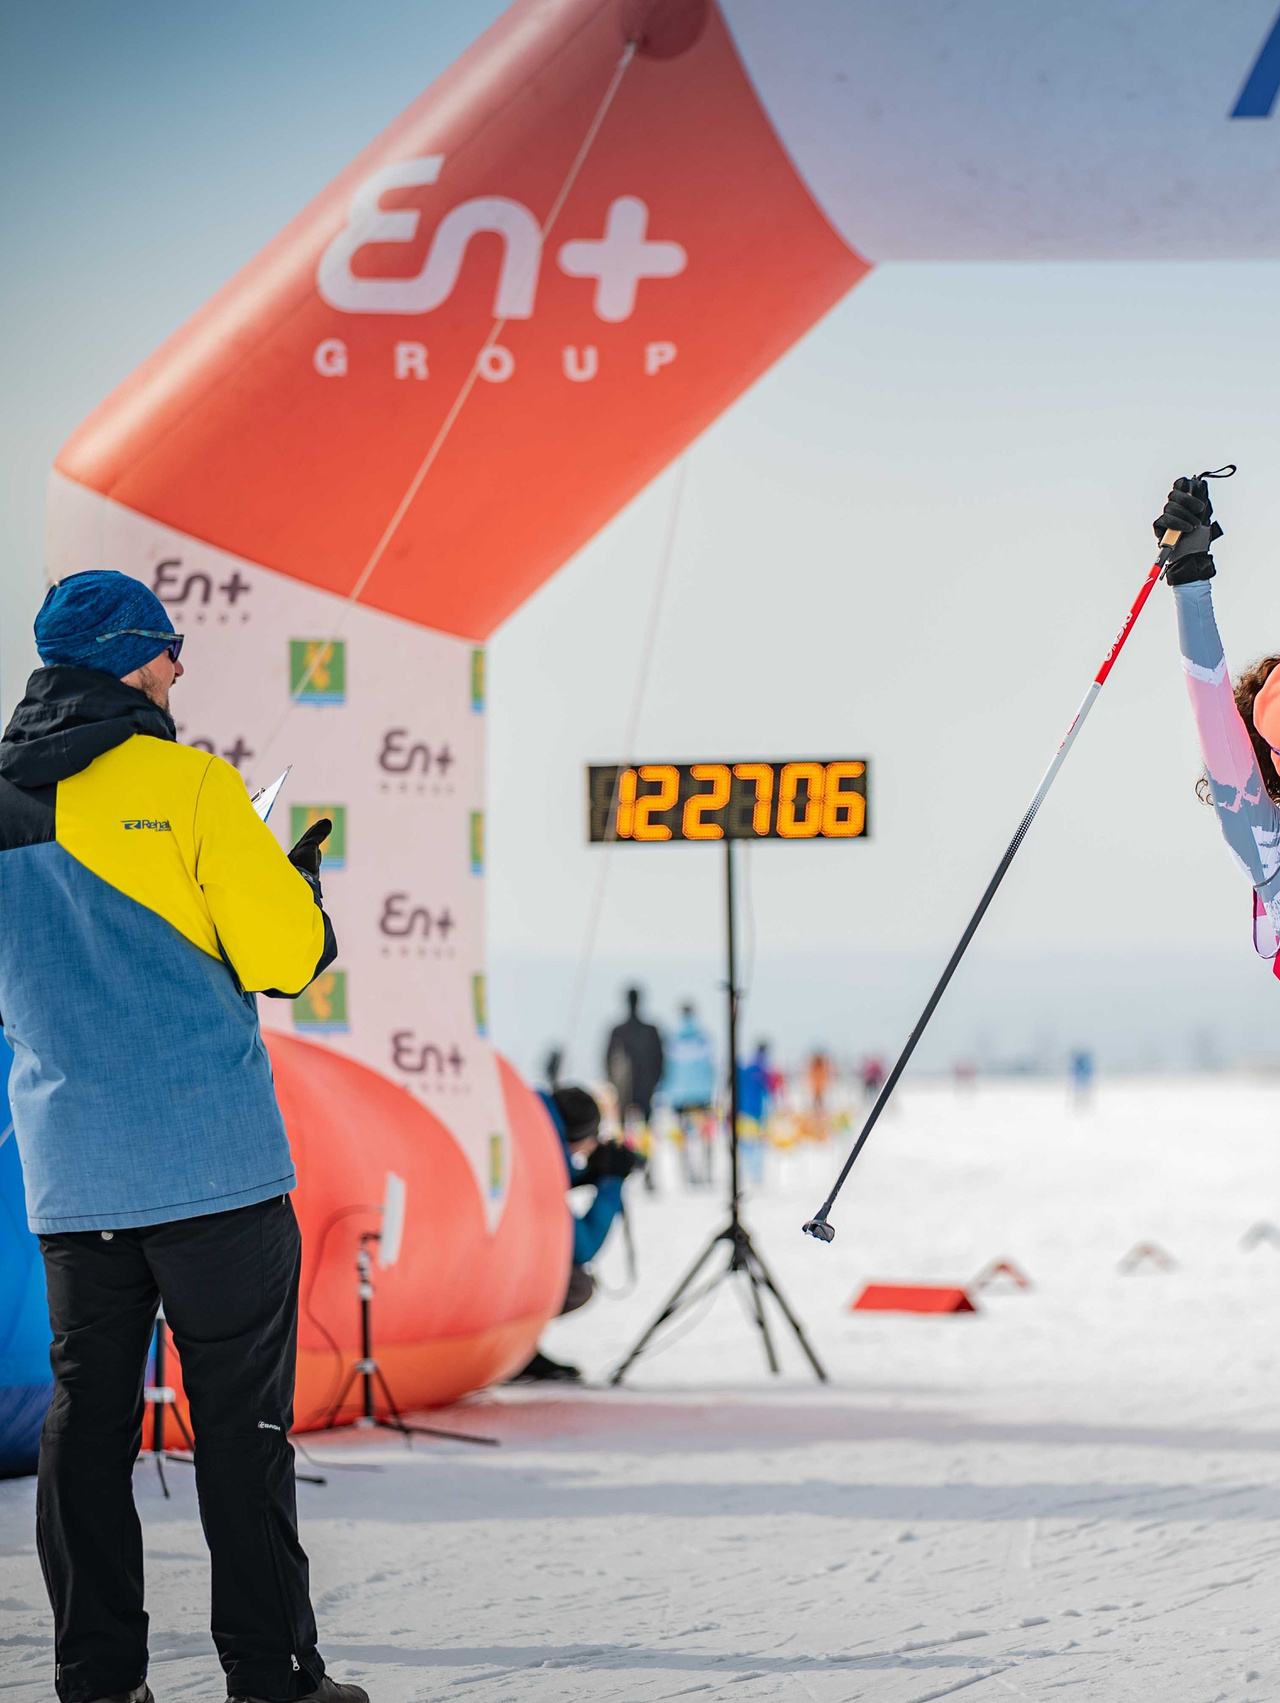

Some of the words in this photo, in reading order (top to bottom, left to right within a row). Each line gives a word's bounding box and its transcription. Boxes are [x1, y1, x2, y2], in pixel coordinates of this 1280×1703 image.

[316, 153, 689, 323] En+
[313, 338, 678, 383] GROUP
[378, 729, 453, 775] En+
[378, 893, 454, 939] En+
